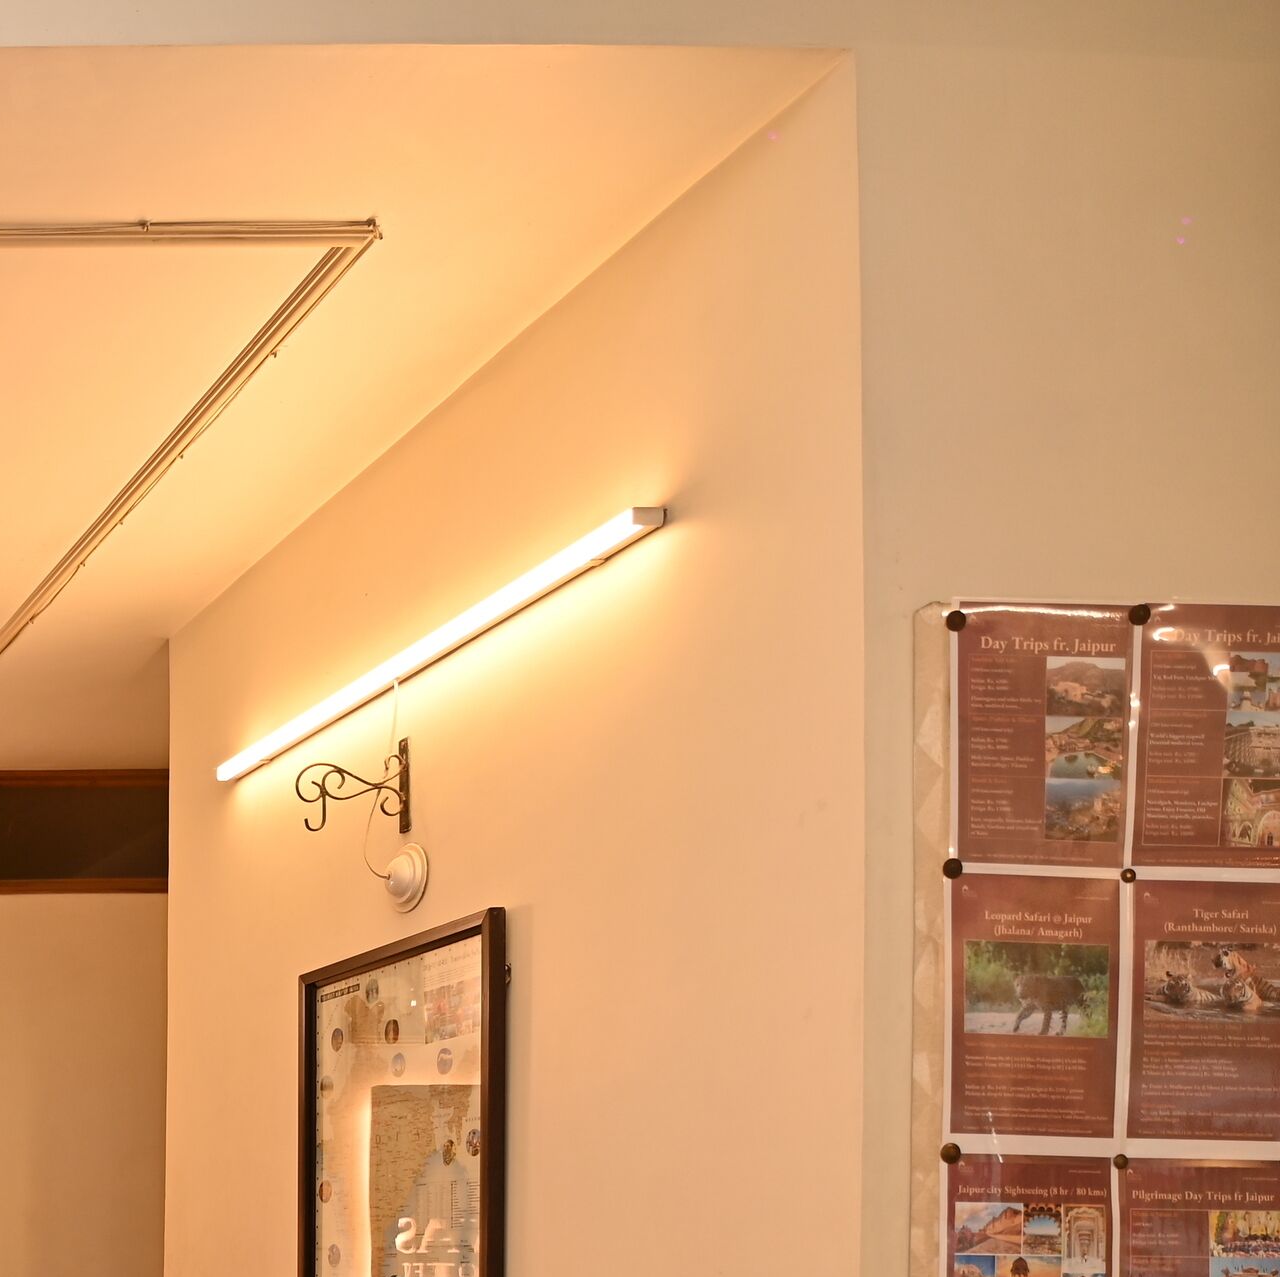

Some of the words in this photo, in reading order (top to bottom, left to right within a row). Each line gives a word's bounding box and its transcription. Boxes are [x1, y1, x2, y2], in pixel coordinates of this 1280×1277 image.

[1176, 629, 1200, 646] Day
[1205, 629, 1242, 646] Trips
[1246, 629, 1261, 643] fr.
[980, 636, 1008, 653] Day
[1012, 637, 1049, 654] Trips
[1053, 637, 1069, 650] fr.
[1072, 638, 1116, 655] Jaipur
[985, 910, 1022, 923] Leopard
[1024, 911, 1051, 922] Safari
[1062, 913, 1092, 926] Jaipur
[1193, 908, 1219, 921] Tiger
[1221, 909, 1249, 919] Safari
[1240, 923, 1277, 936] Sariska)
[958, 1184, 985, 1195] Jaipur
[987, 1185, 1002, 1196] city
[1004, 1185, 1048, 1197] Sightseeing
[1059, 1186, 1068, 1196] hr
[1132, 1190, 1182, 1203] Pilgrimage
[1185, 1191, 1202, 1203] Day
[1206, 1191, 1231, 1204] Trips
[1245, 1192, 1275, 1204] Jaipur
